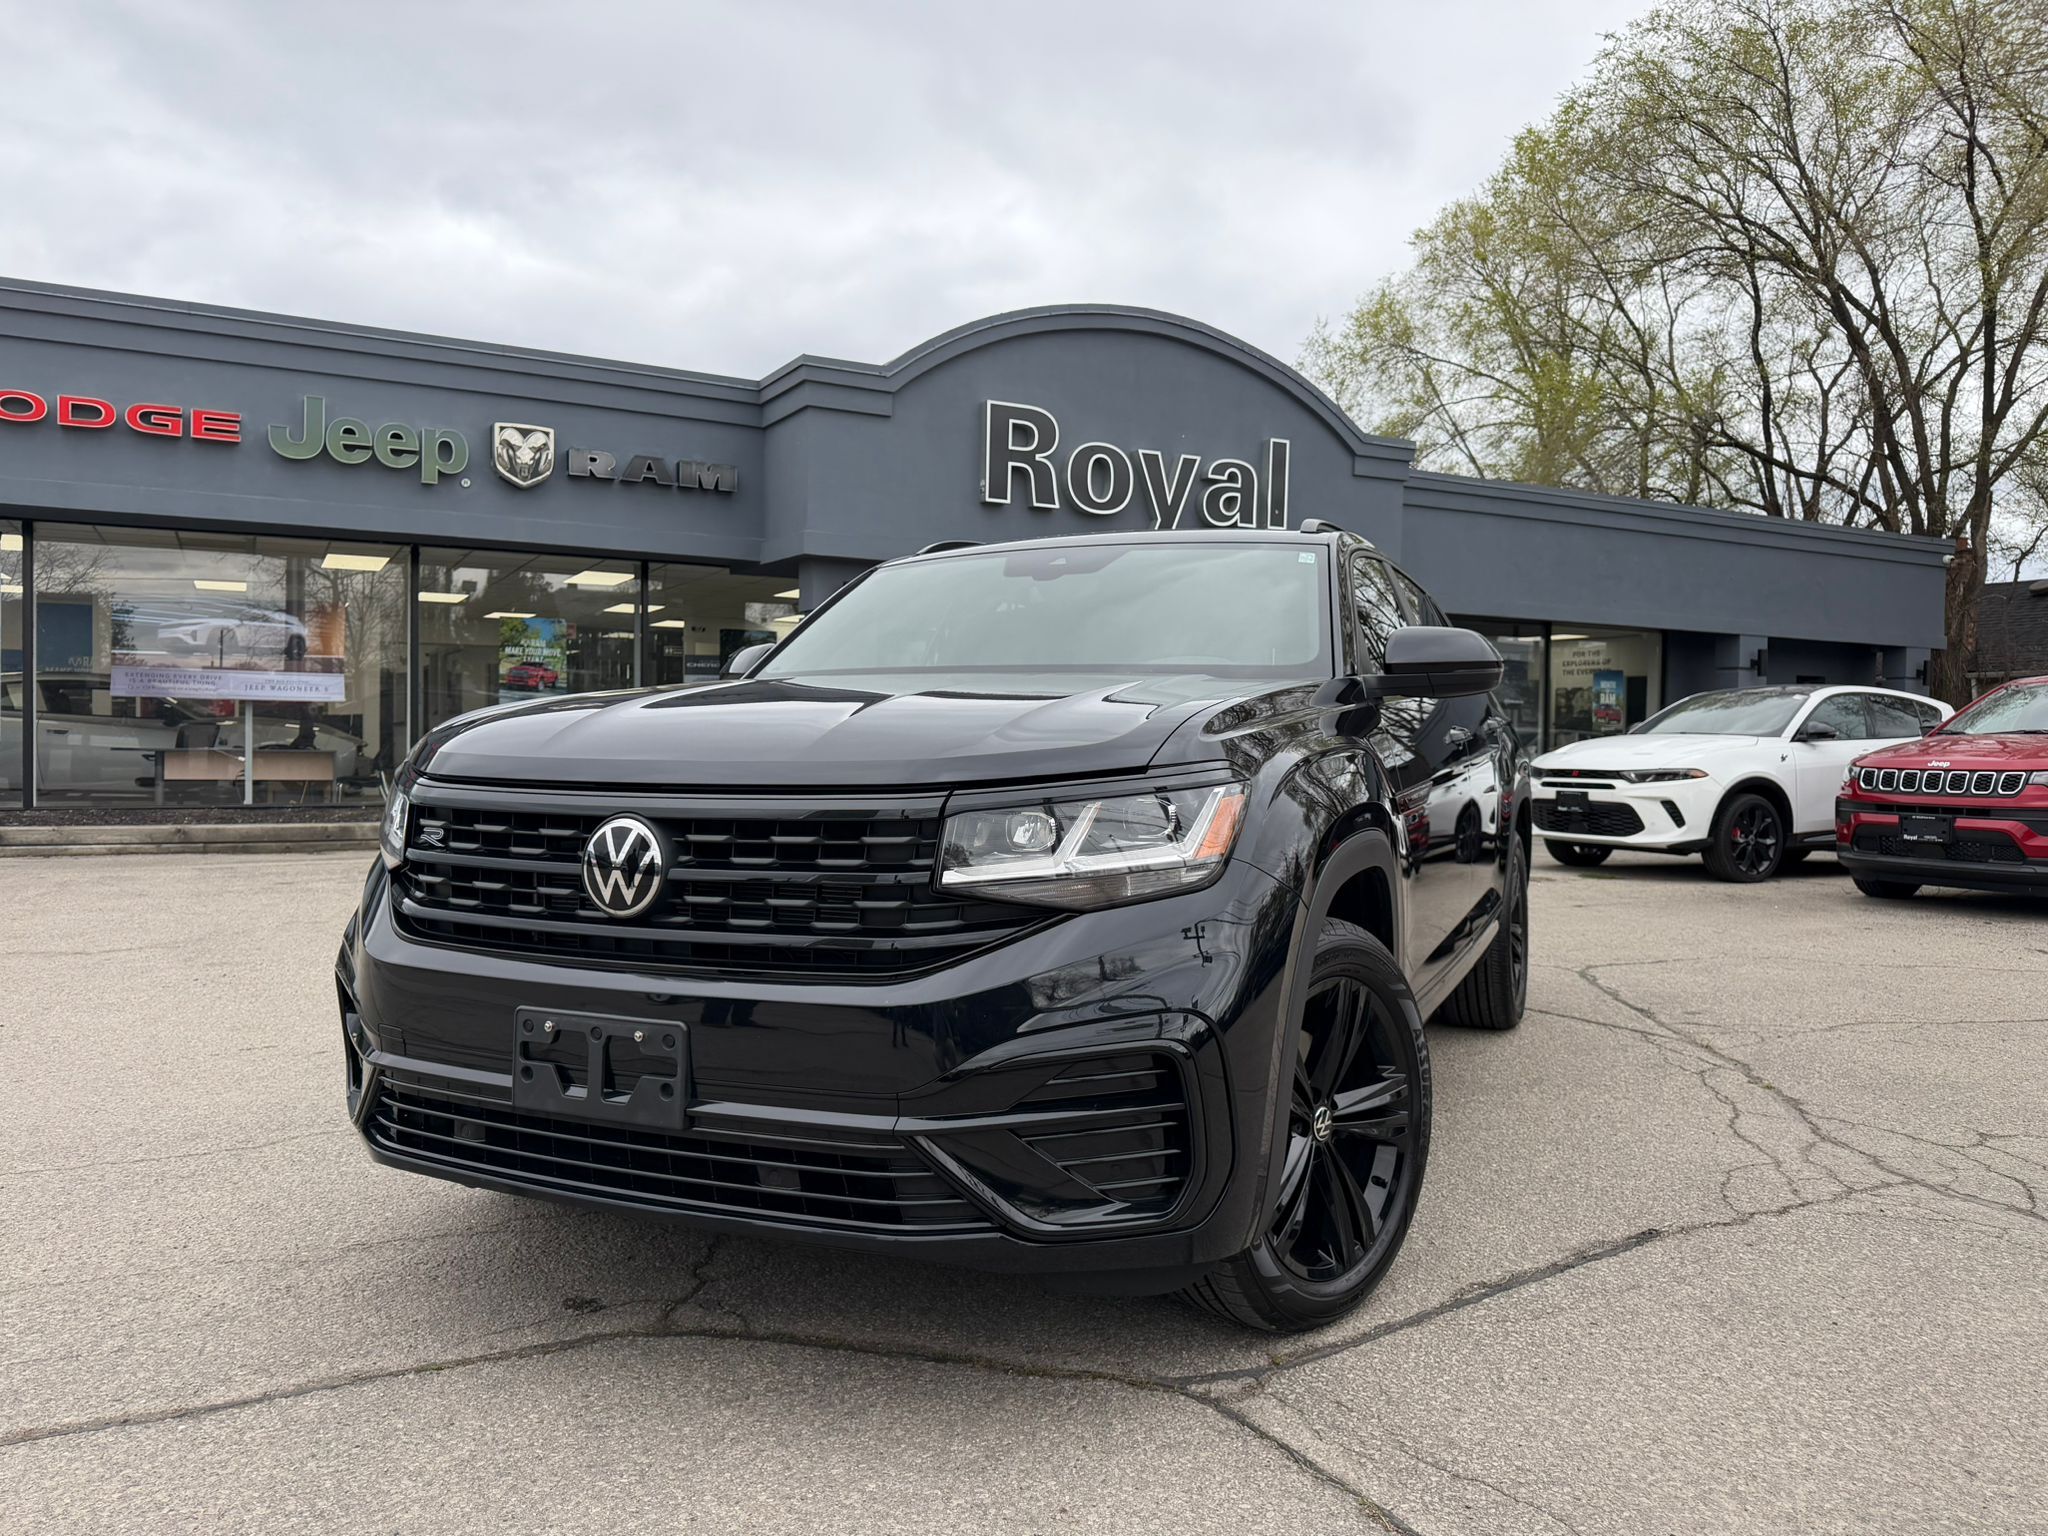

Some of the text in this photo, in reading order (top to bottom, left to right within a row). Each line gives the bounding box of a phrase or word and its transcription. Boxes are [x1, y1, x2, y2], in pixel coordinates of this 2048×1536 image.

[267, 395, 470, 485] Jeep
[566, 447, 738, 493] RAM
[984, 400, 1290, 530] Royal
[505, 646, 523, 655] MAKE
[525, 647, 542, 656] YOUR
